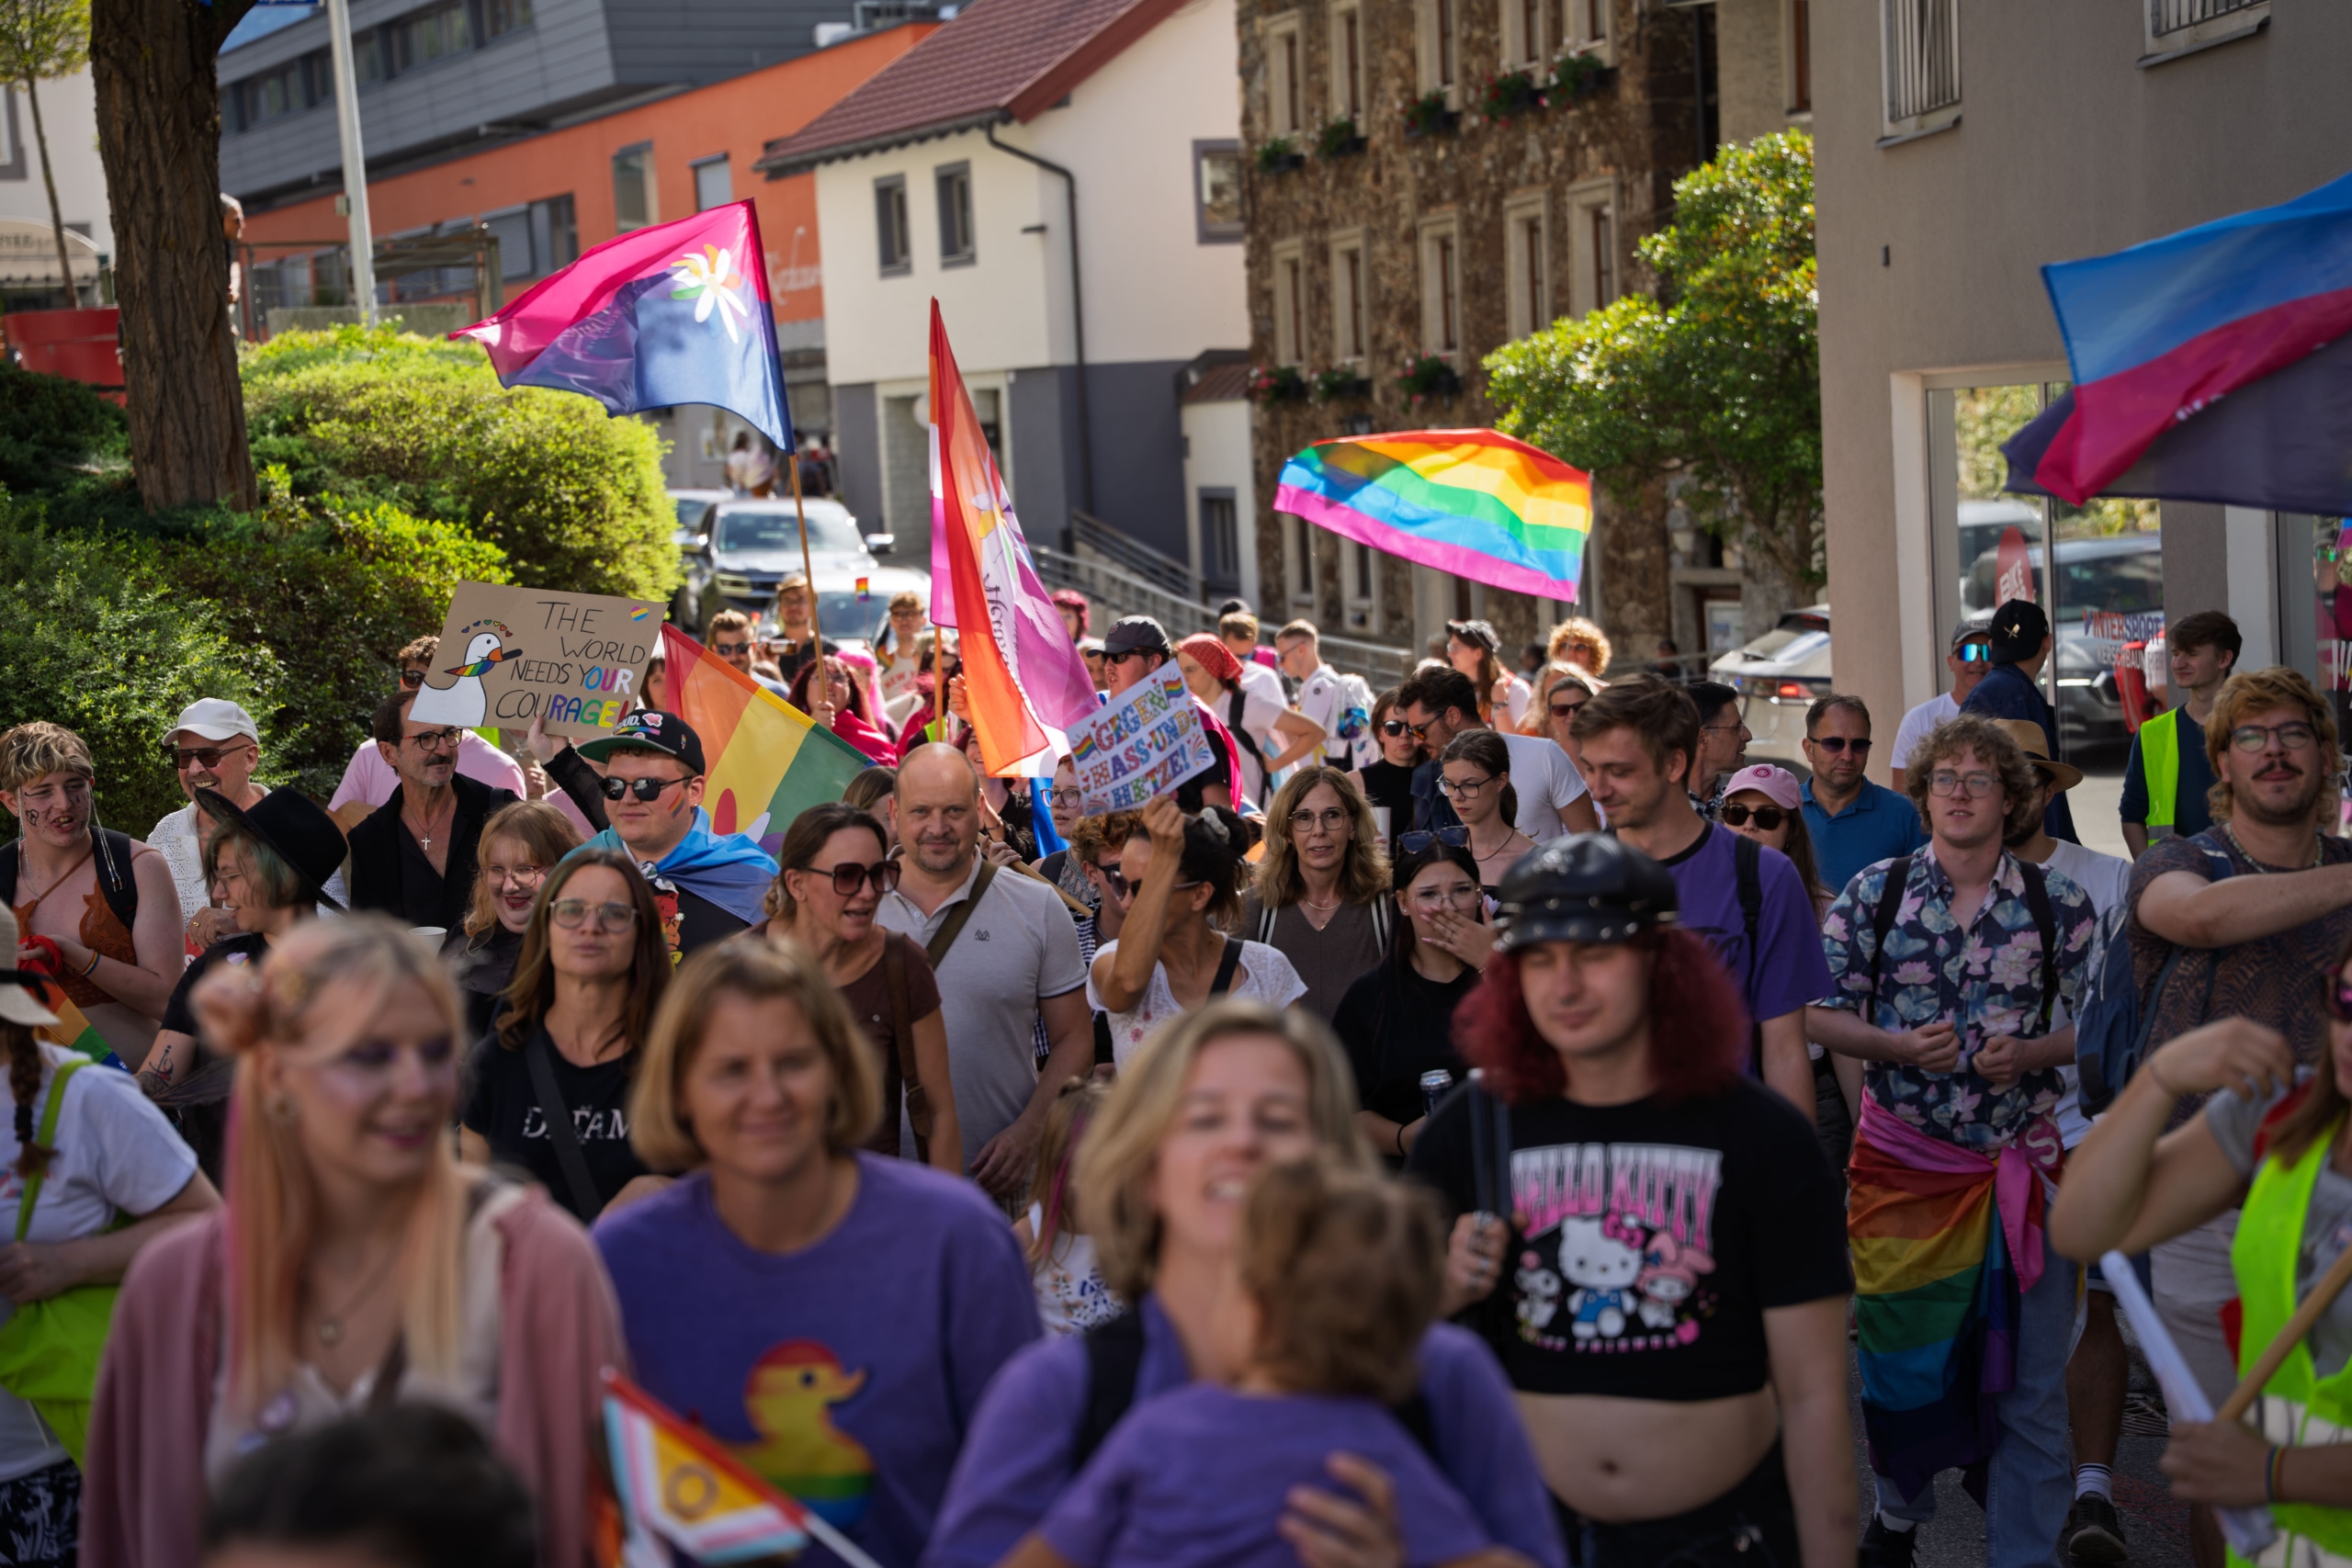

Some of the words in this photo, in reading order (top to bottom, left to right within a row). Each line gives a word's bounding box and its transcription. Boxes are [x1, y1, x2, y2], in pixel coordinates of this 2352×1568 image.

[1999, 558, 2023, 603] BIKE
[537, 602, 604, 635] THE
[2093, 610, 2162, 645] INTERSPORT
[560, 636, 646, 664] WORLD
[510, 660, 573, 684] NEEDS
[579, 664, 634, 694] YOUR
[1095, 684, 1170, 751] GEGEN
[1091, 738, 1150, 789] HASS
[1148, 710, 1191, 752] UND
[1112, 744, 1191, 808] HETZE!
